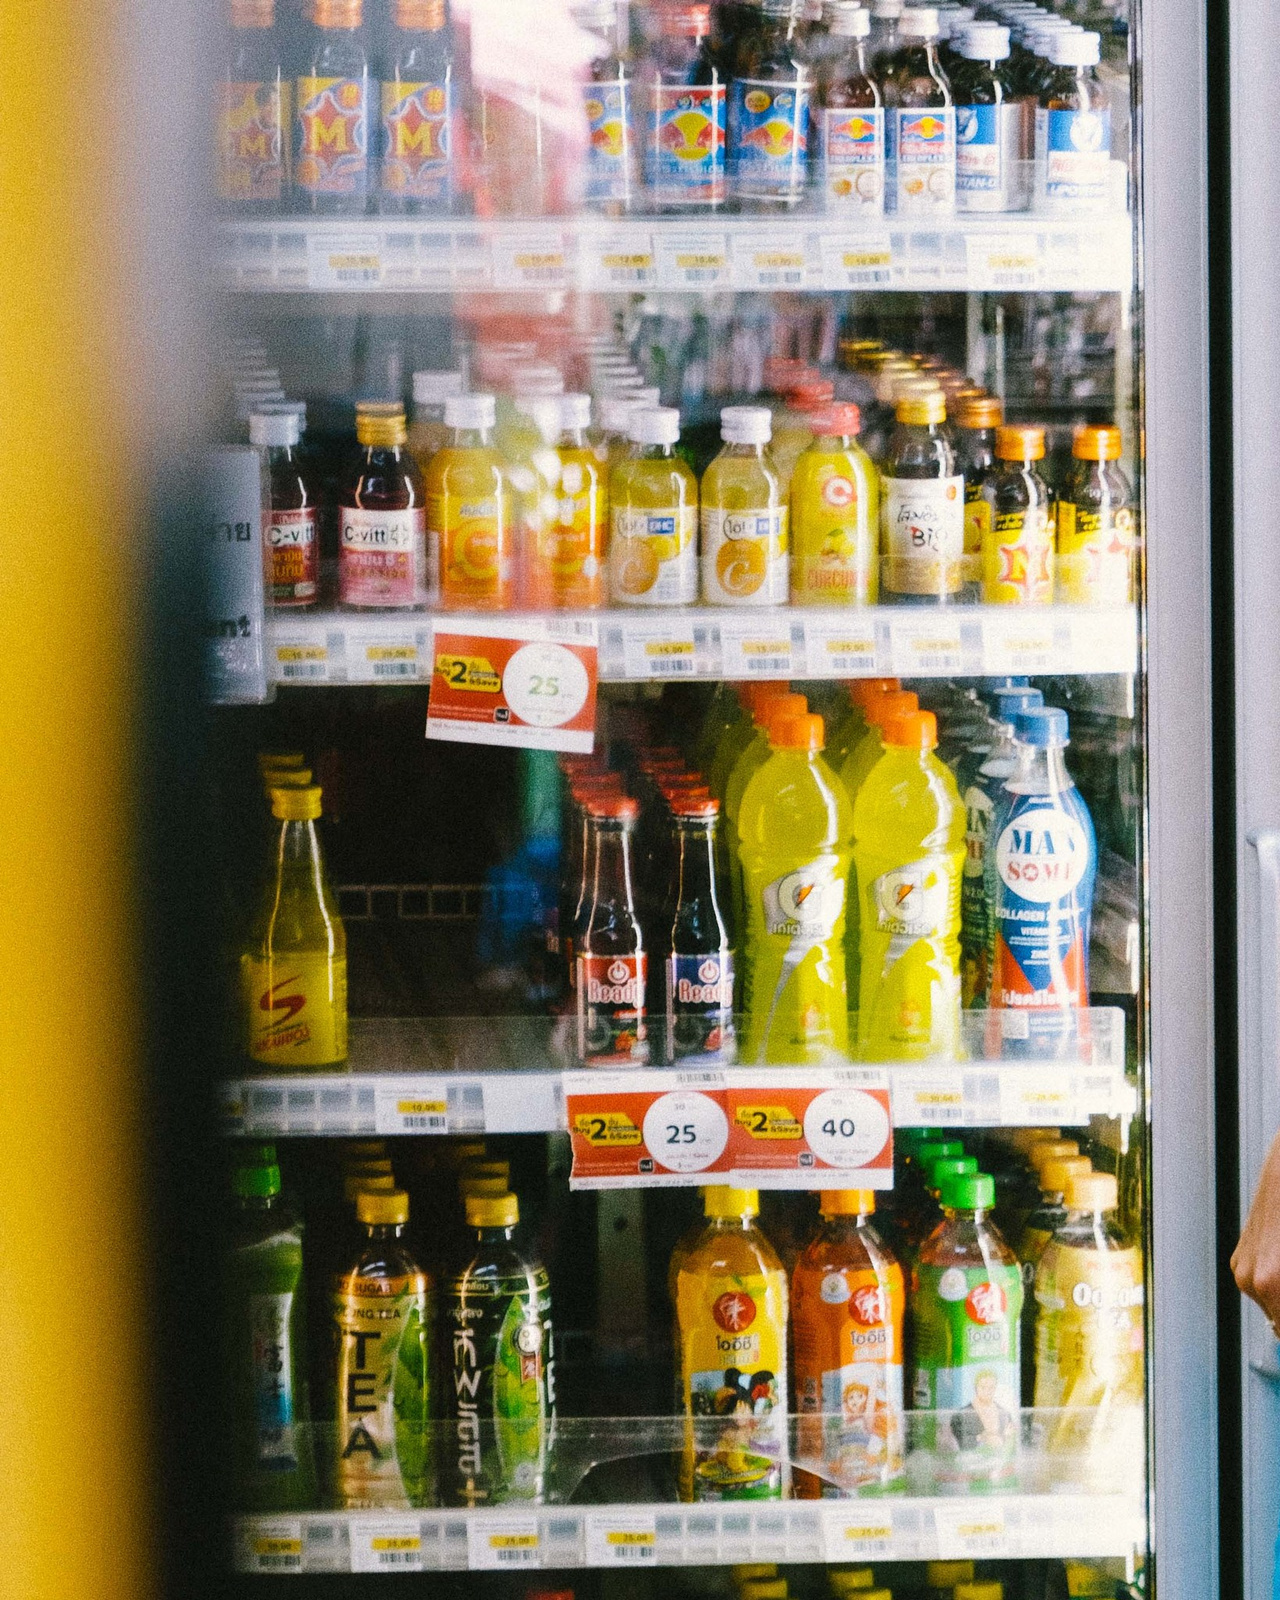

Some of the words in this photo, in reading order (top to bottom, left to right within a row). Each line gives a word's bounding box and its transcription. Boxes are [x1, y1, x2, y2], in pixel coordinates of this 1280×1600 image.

[343, 525, 387, 543] C-vitt
[450, 661, 468, 684] 2
[528, 675, 560, 697] 25
[590, 1119, 608, 1140] 2
[751, 1111, 768, 1132] 2
[822, 1119, 855, 1138] 40
[665, 1124, 697, 1144] 25
[341, 1330, 382, 1460] TEA
